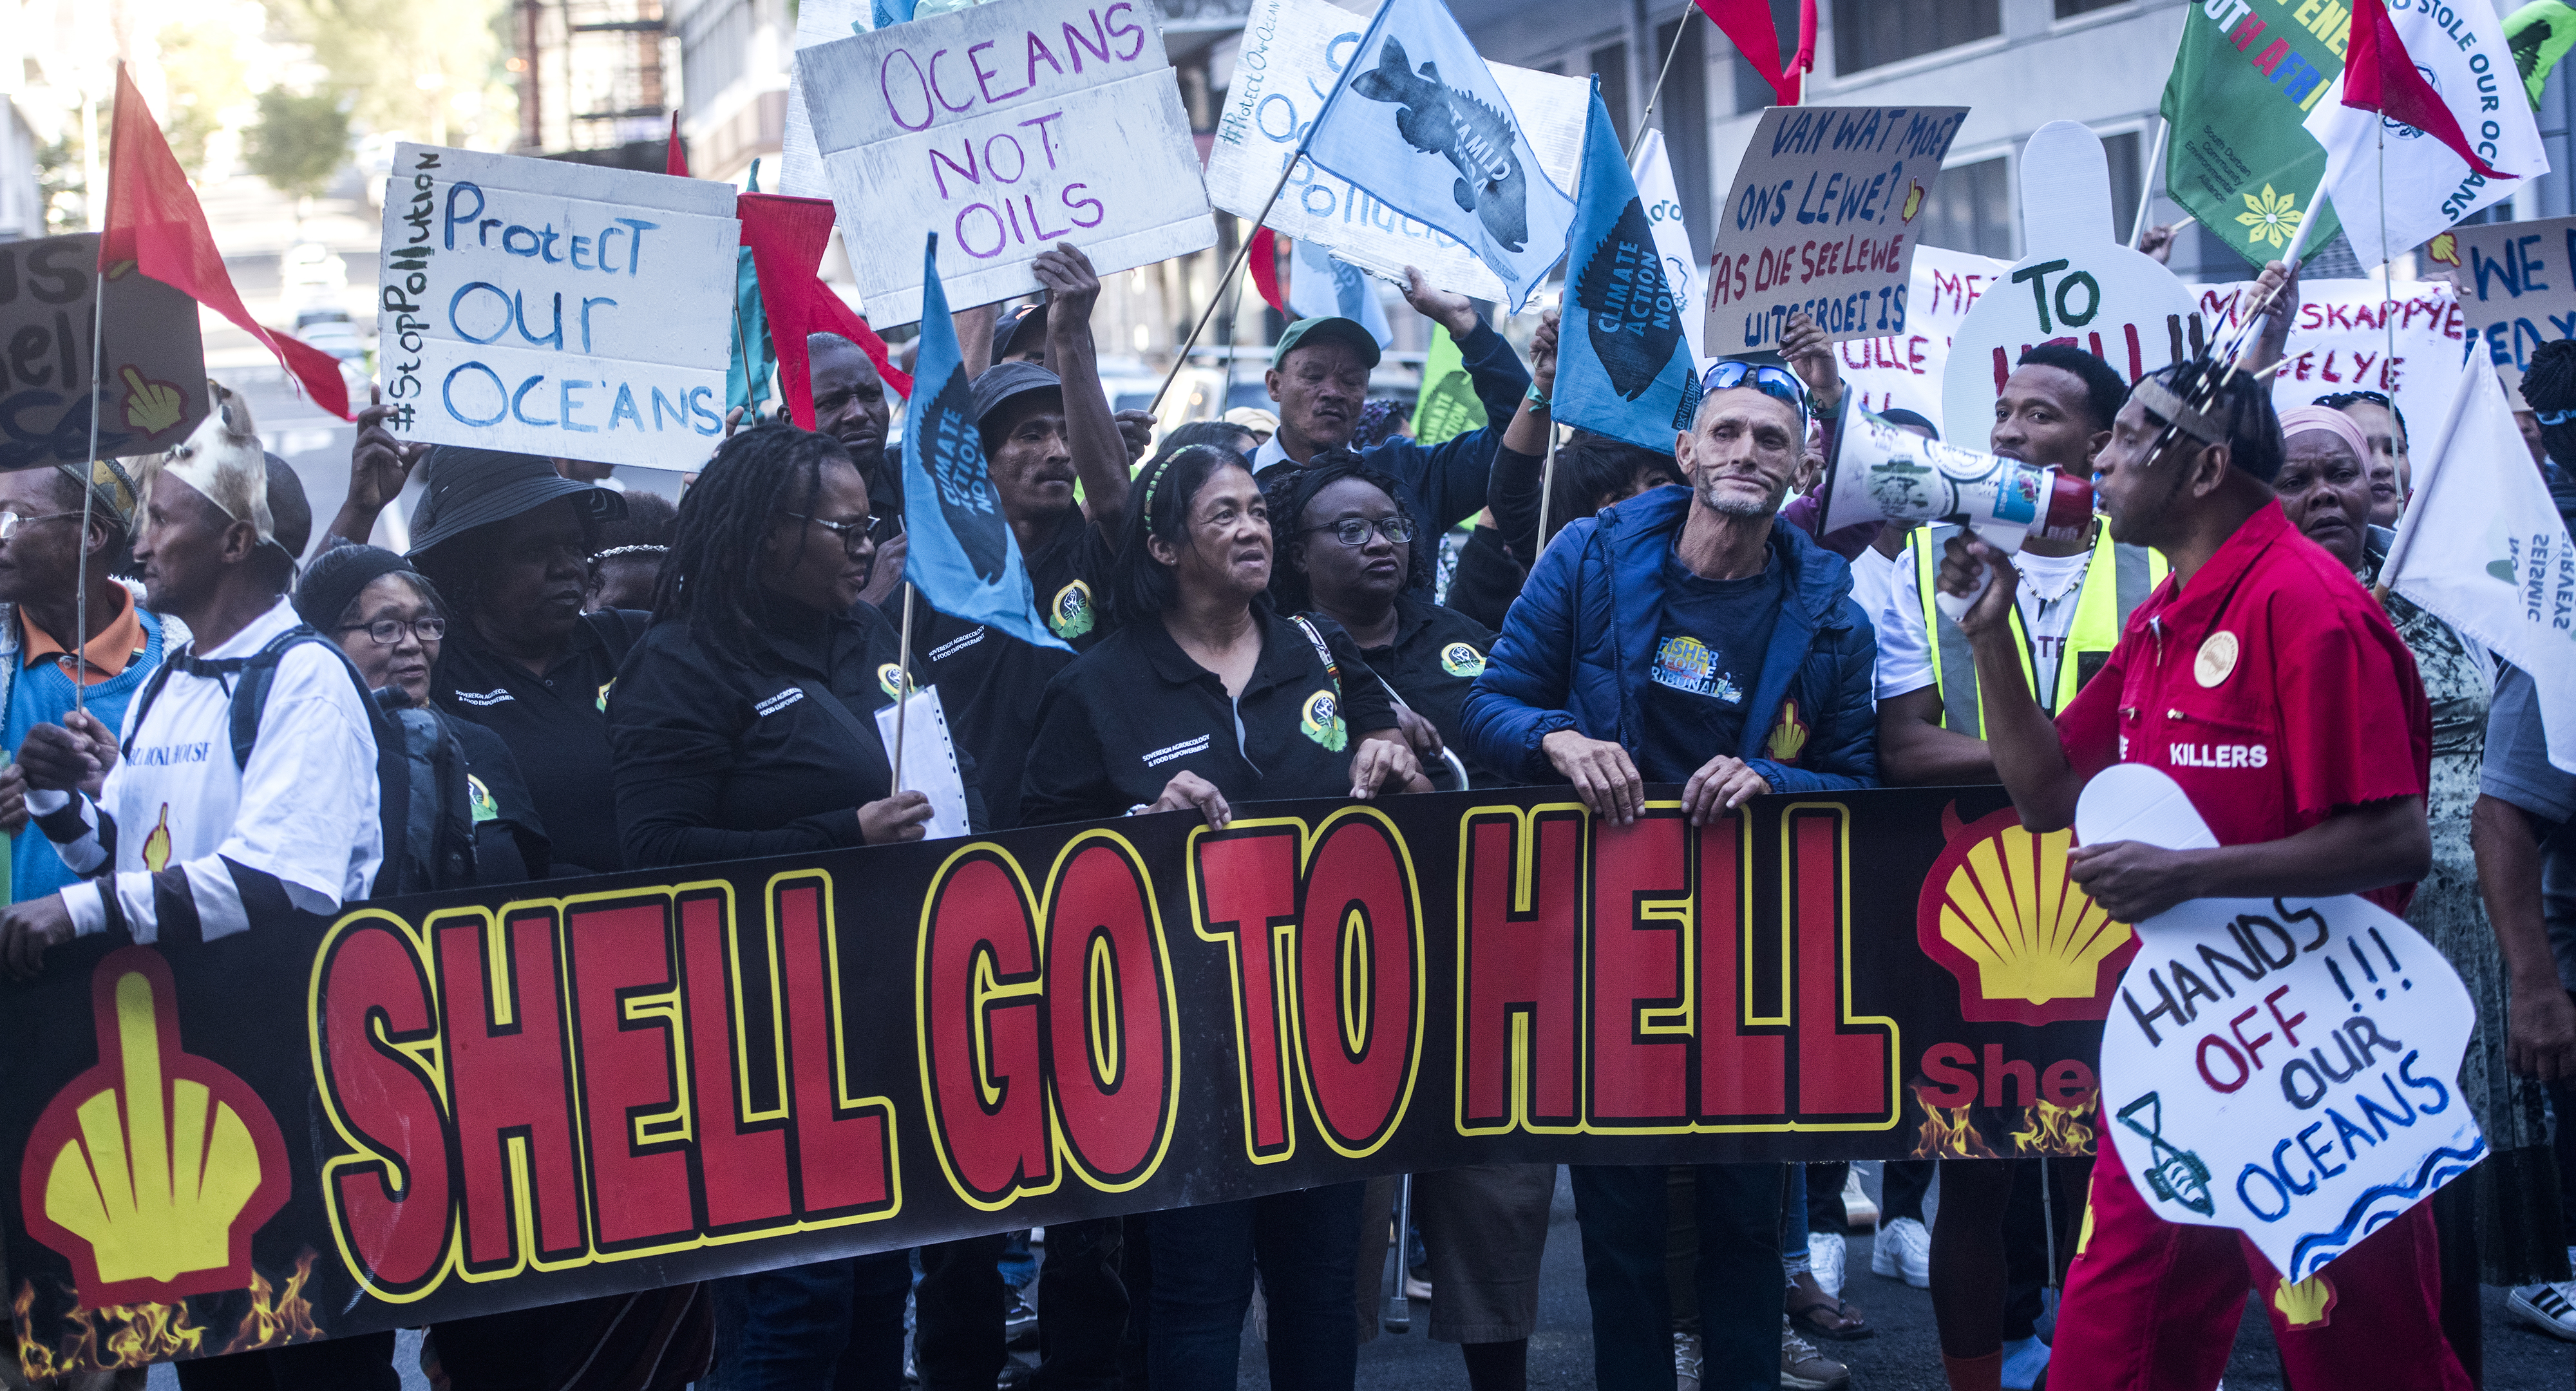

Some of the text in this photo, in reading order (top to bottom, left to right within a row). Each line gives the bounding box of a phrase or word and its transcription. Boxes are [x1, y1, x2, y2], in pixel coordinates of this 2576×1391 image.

[880, 2, 1145, 132] OCEANS
[2418, 0, 2477, 52] STOLE
[2469, 53, 2499, 113] OUR
[929, 111, 1063, 200] NOT
[1772, 108, 1967, 162] VAN WAT MOET
[2204, 125, 2251, 176] South Durban
[2185, 140, 2237, 195] Environmental
[2198, 175, 2226, 204] Alliance
[2202, 141, 2244, 186] Community
[955, 183, 1104, 259] OILS
[1737, 180, 1794, 231] ONS
[1796, 161, 1903, 225] LEWE?
[1598, 241, 1638, 334] CLIMATE
[1625, 251, 1657, 337] ACTION
[1755, 245, 1795, 292] DIE
[2471, 234, 2549, 301] WE
[1653, 272, 1673, 330] NOW
[1877, 283, 1907, 334] IS
[2011, 258, 2101, 334] TO
[1435, 401, 1469, 443] CTION
[1676, 377, 1695, 429] extinction
[934, 406, 963, 507] CLIMATE
[952, 424, 980, 516] ACTION
[971, 452, 995, 515] NOW
[929, 625, 985, 658] SOVEREIGN AGROECOLOGY
[937, 650, 951, 660] FOOD
[951, 633, 985, 654] EMPOWERMENT
[1654, 650, 1717, 680] PEOPLE
[1657, 636, 1719, 667] FISHER
[455, 688, 509, 699] SOVEREIGN AGROECO
[478, 695, 515, 706] EMPOWERMEN
[1651, 665, 1716, 695] RIBUNAL
[759, 706, 775, 717] FOOD
[1142, 734, 1209, 762] SOVEREIGN AGROECOLOGY
[1153, 755, 1169, 765] FOOD
[1168, 743, 1209, 760] EMPOWERMENT
[2169, 742, 2268, 768] KILLERS
[2123, 896, 2330, 1048] HANDS
[2195, 926, 2412, 1093] OFF !!!
[309, 800, 1900, 1304] SHELL GO TO HELL
[2280, 1016, 2403, 1110] OUR
[2235, 1049, 2450, 1223] OCEANS
